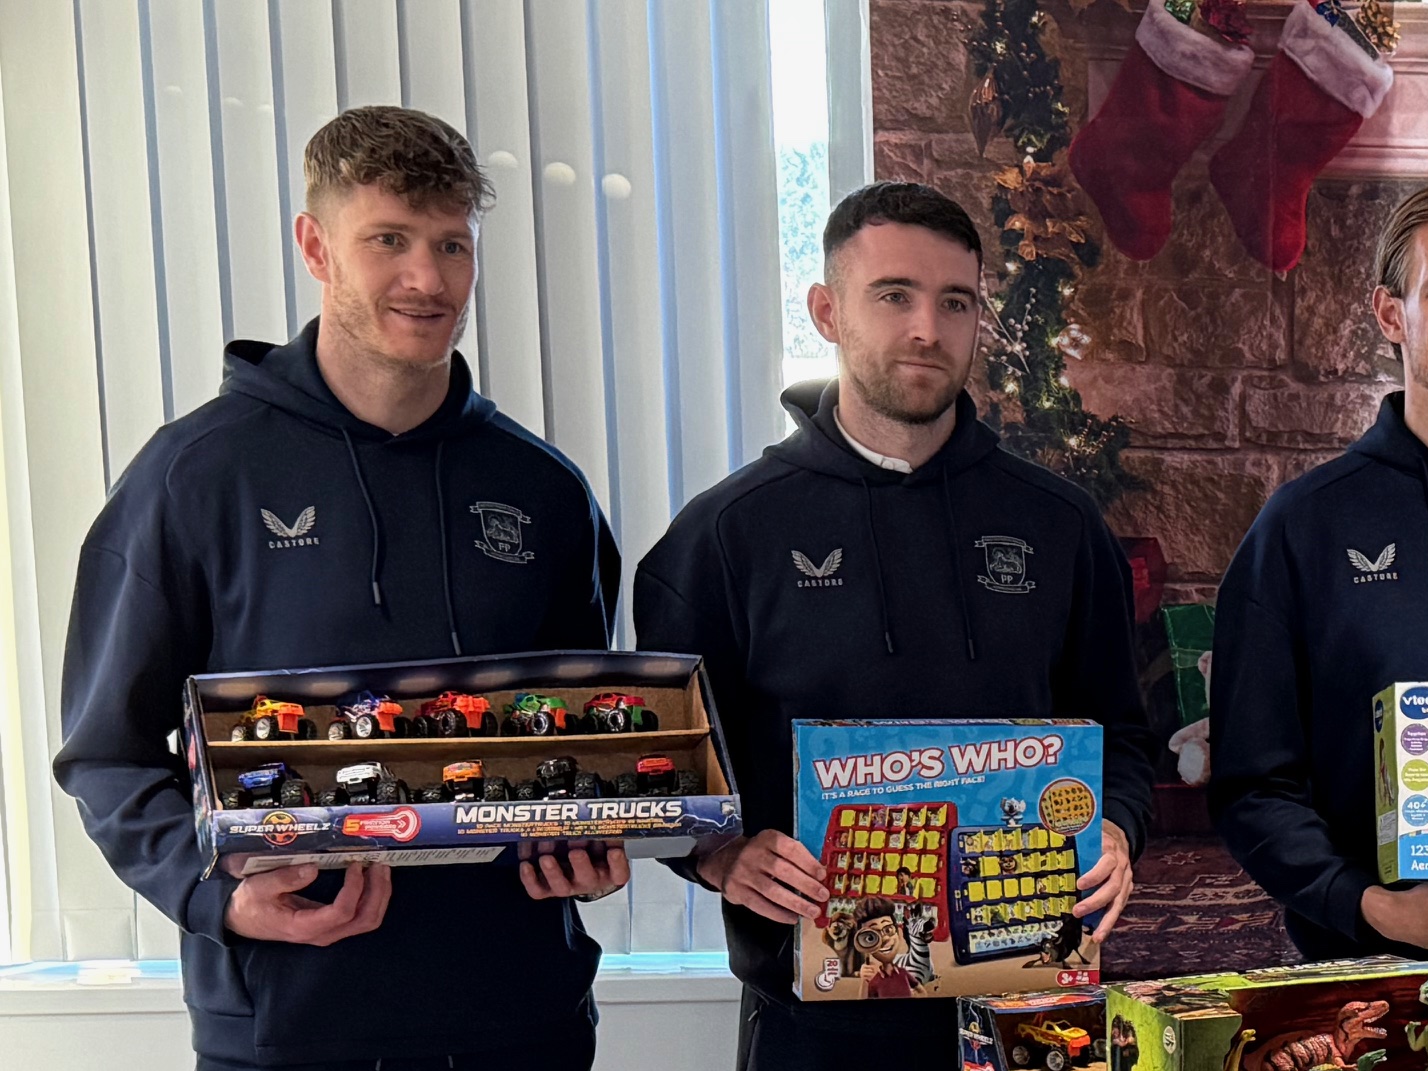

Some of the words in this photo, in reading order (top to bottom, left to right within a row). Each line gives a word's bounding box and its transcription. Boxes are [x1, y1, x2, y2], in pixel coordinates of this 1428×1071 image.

[269, 537, 320, 548] CASTORE
[797, 578, 843, 588] CASTORE
[1001, 574, 1013, 584] PP
[813, 747, 945, 789] WHO'S
[948, 734, 1063, 776] WHO?
[847, 789, 871, 799] RACE
[886, 784, 913, 794] GUESS
[915, 782, 933, 792] THE
[934, 779, 960, 789] RIGHT
[961, 776, 985, 786] FACE!
[456, 803, 578, 823] MONSTER
[588, 801, 682, 820] TRUCKS
[230, 822, 275, 834] SUPER
[276, 822, 331, 833] WHEELZ
